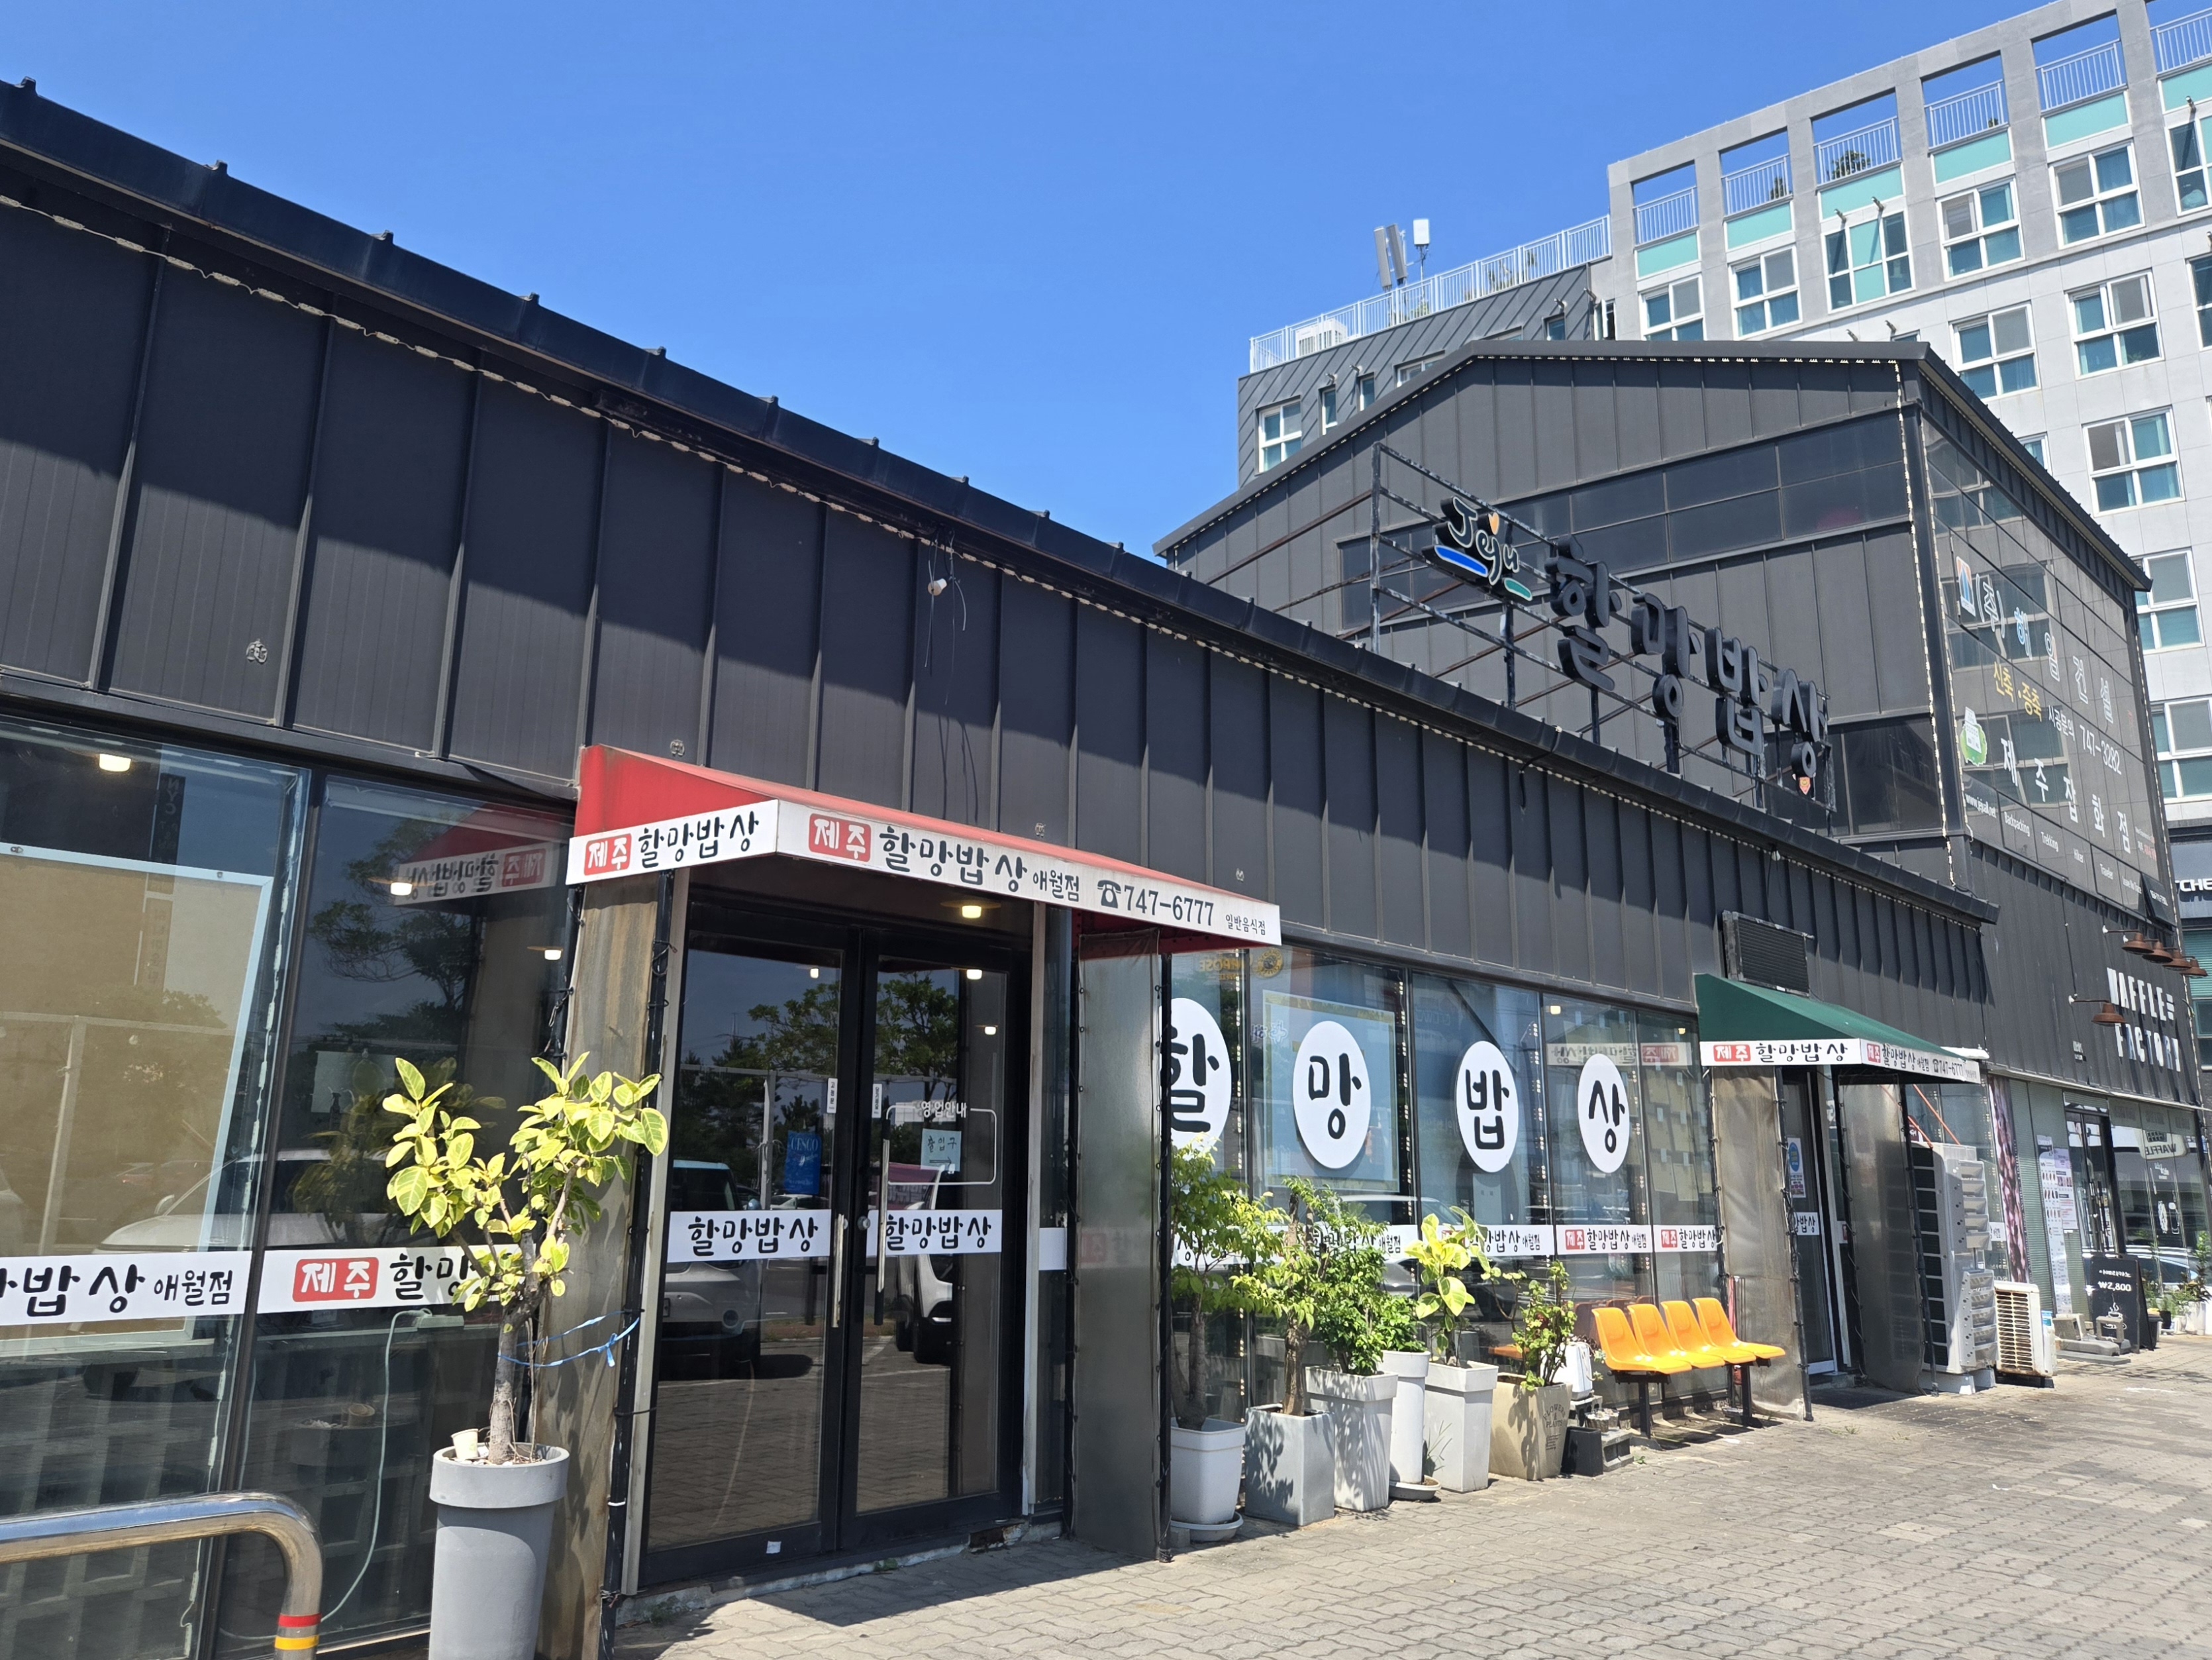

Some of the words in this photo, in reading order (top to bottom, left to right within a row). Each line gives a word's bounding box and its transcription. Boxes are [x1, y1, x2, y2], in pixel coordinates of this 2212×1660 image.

[1446, 495, 1520, 586] Jeju
[1544, 534, 1826, 778] 할망밥상
[2048, 705, 2075, 741] 시공문의
[2080, 725, 2122, 775] 747-3282
[588, 837, 627, 870] 제주
[638, 811, 759, 868] 할망밥상
[814, 818, 866, 859] 제주
[879, 825, 1028, 892] 할망밥상
[1032, 870, 1080, 902] 애월점
[1123, 885, 1215, 926] 747-6777
[1225, 913, 1266, 935] 일반음식점
[2175, 878, 2212, 892] CHE
[2107, 967, 2167, 1021] WAFFLE
[1715, 1045, 1750, 1061] 제주
[1756, 1043, 1848, 1063] 할망밥상
[1867, 1044, 1881, 1063] 제주
[1882, 1044, 1915, 1071] 할망밥상
[921, 1101, 967, 1118] 영업안내
[791, 1135, 819, 1151] CESCO
[688, 1216, 819, 1257] 할망밥상
[885, 1215, 992, 1251] 할망밥상
[1378, 1235, 1401, 1253] 애월점
[1522, 1233, 1540, 1251] 애월점
[1566, 1231, 1584, 1249] 제주
[1587, 1228, 1630, 1251] 할망밥상
[1631, 1233, 1646, 1249] 애월점
[1661, 1231, 1678, 1248] 제주
[1678, 1228, 1716, 1249] 할망밥상
[154, 1270, 233, 1306] 애월점
[301, 1261, 371, 1299] 제주
[1542, 1404, 1566, 1420] FLOWERS
[1546, 1420, 1563, 1428] PLANTS
